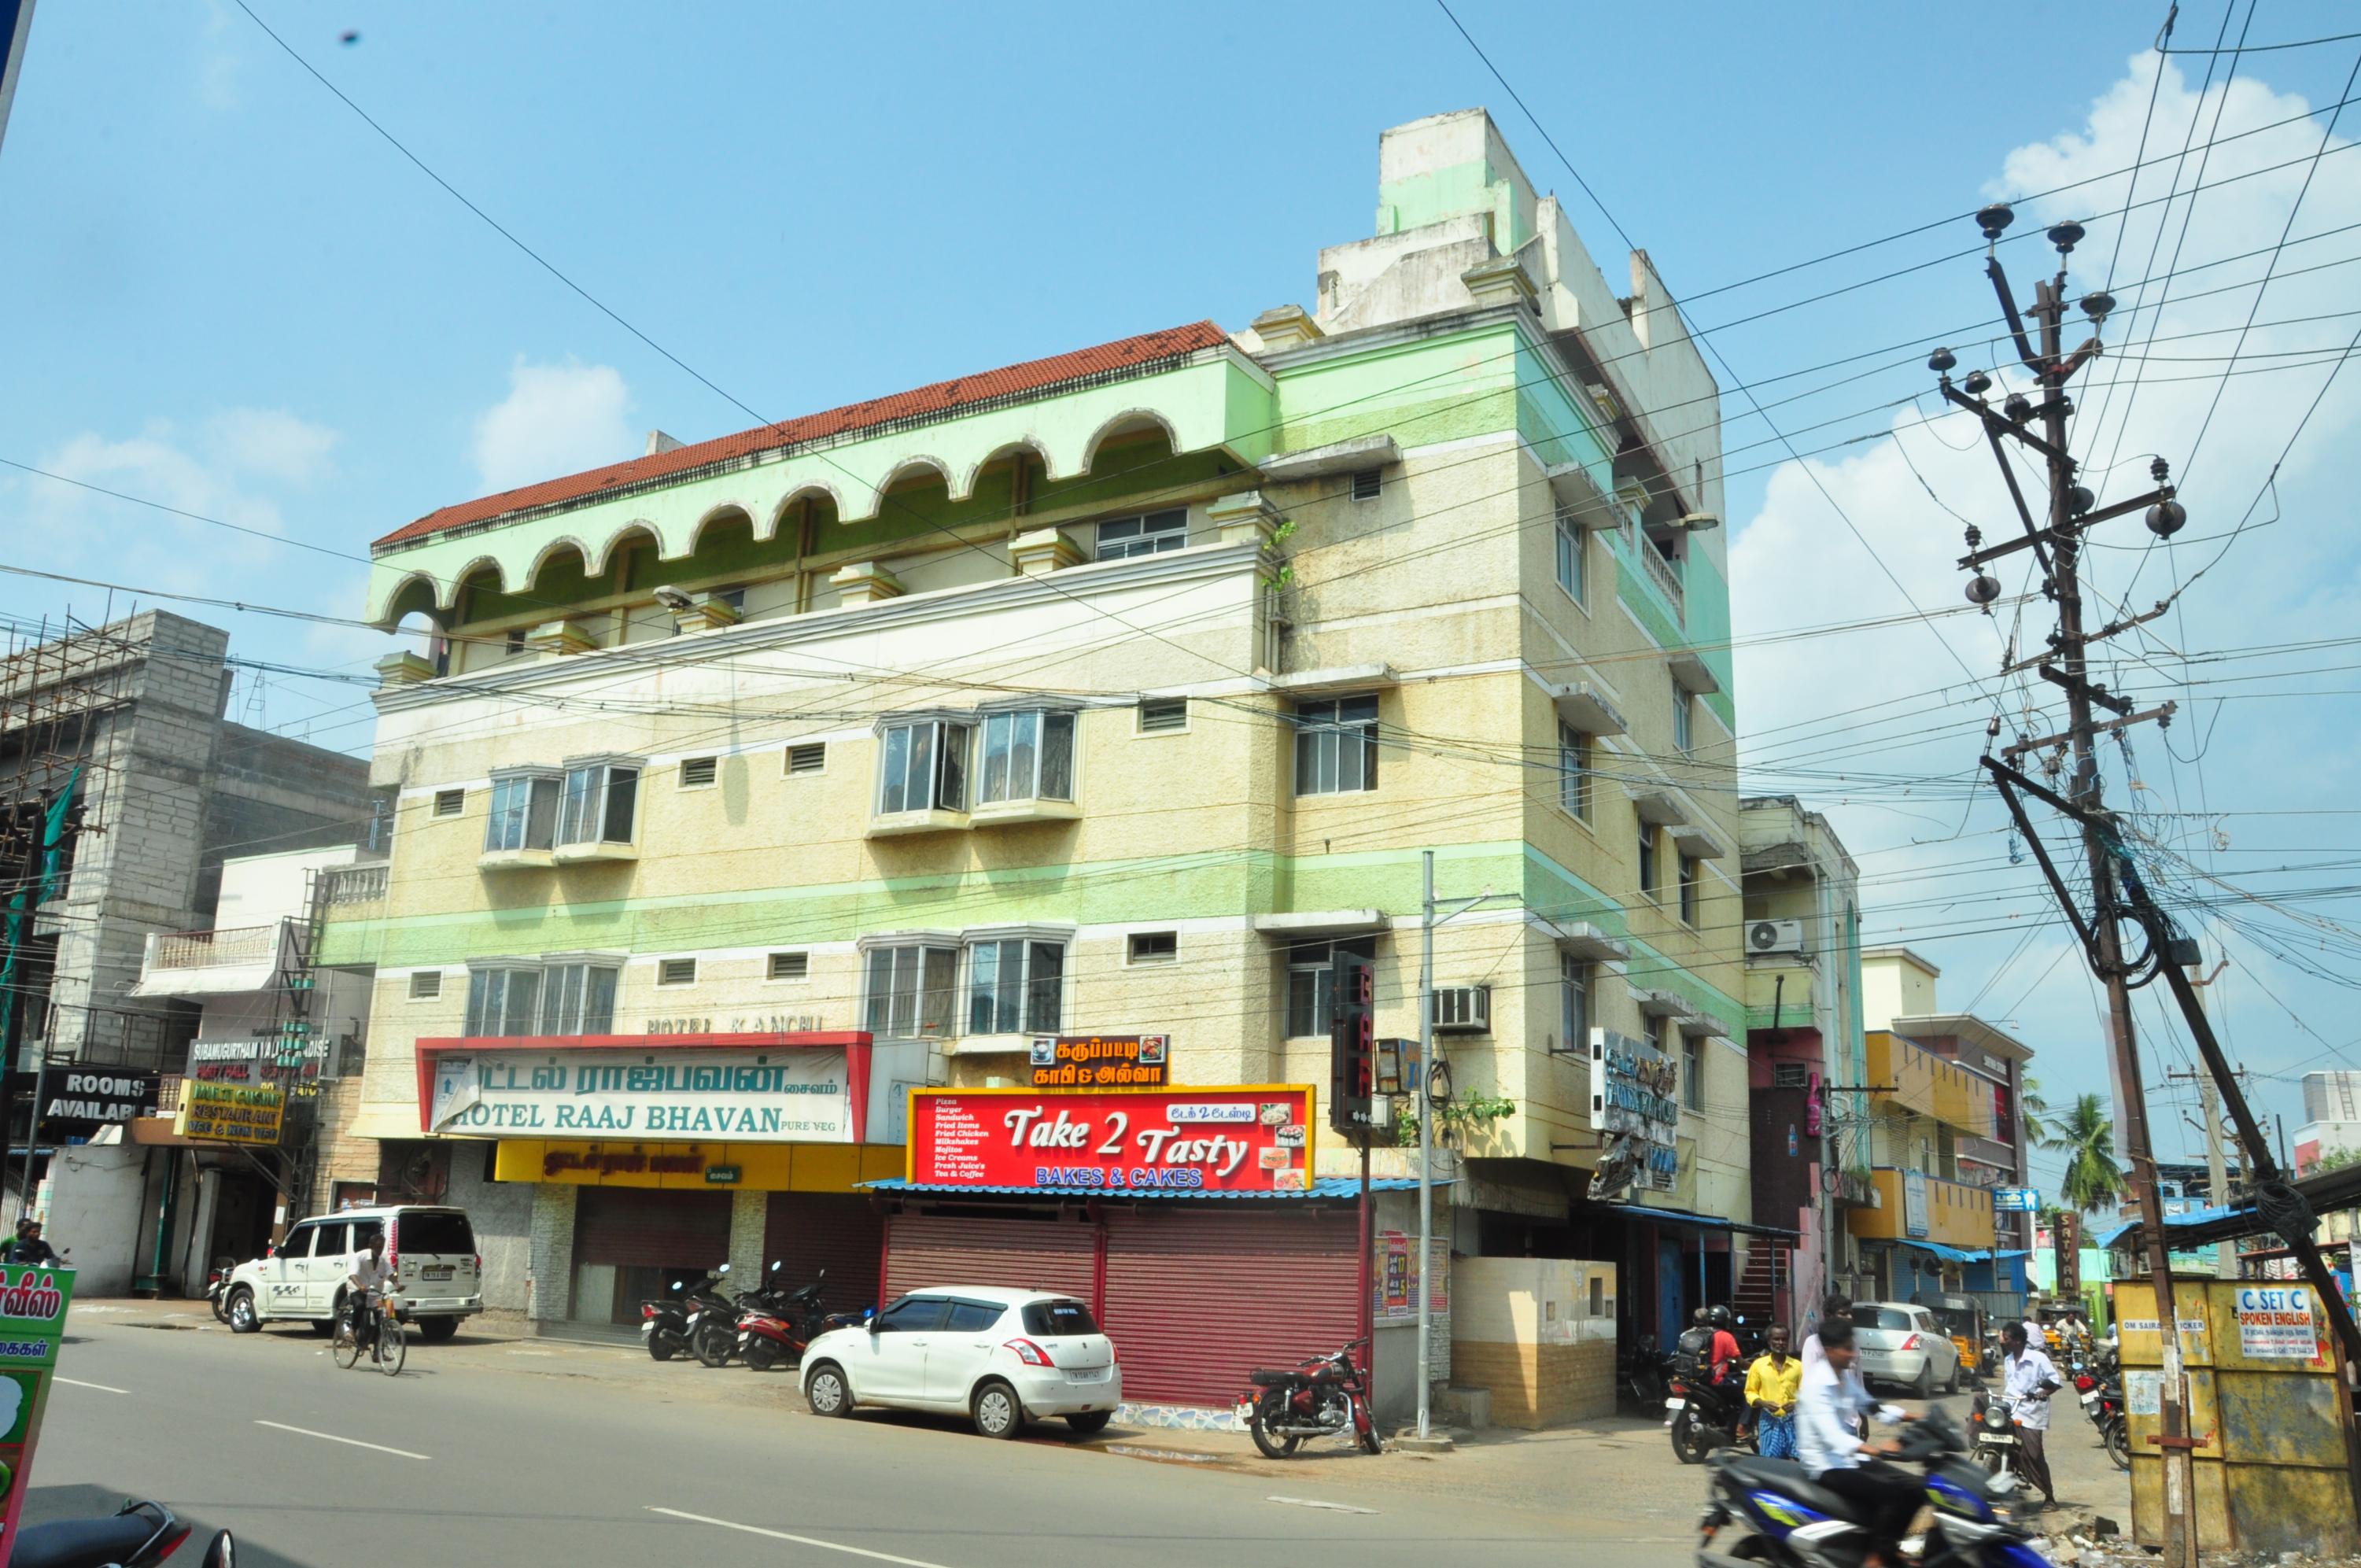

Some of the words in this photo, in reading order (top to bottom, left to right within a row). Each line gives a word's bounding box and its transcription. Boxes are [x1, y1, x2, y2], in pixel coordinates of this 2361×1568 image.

[575, 1055, 789, 1097] ராஜ்பவன்
[784, 1079, 838, 1094] சைவம்
[1033, 1064, 1075, 1084] காபி
[1095, 1062, 1160, 1083] அல்வா
[66, 1074, 145, 1098] ROOMS
[193, 1104, 279, 1125] RESTAURANT
[555, 1105, 636, 1130] RAAJ
[646, 1105, 783, 1132] BHAVAN
[781, 1121, 810, 1131] PURE
[813, 1121, 836, 1131] VEG
[1200, 1106, 1210, 1118] 2
[1004, 1105, 1090, 1148] Take
[1095, 1111, 1128, 1154] 2
[1136, 1125, 1249, 1177] Tasty
[1035, 1166, 1103, 1186] BAKES
[1109, 1168, 1125, 1186] &
[1130, 1167, 1202, 1187] CAKES
[2242, 1290, 2256, 1310] C
[2260, 1291, 2285, 1310] SET
[2291, 1290, 2304, 1310] C
[2240, 1312, 2273, 1326] SPOKEN
[2274, 1312, 2311, 1326] ENGLISH
